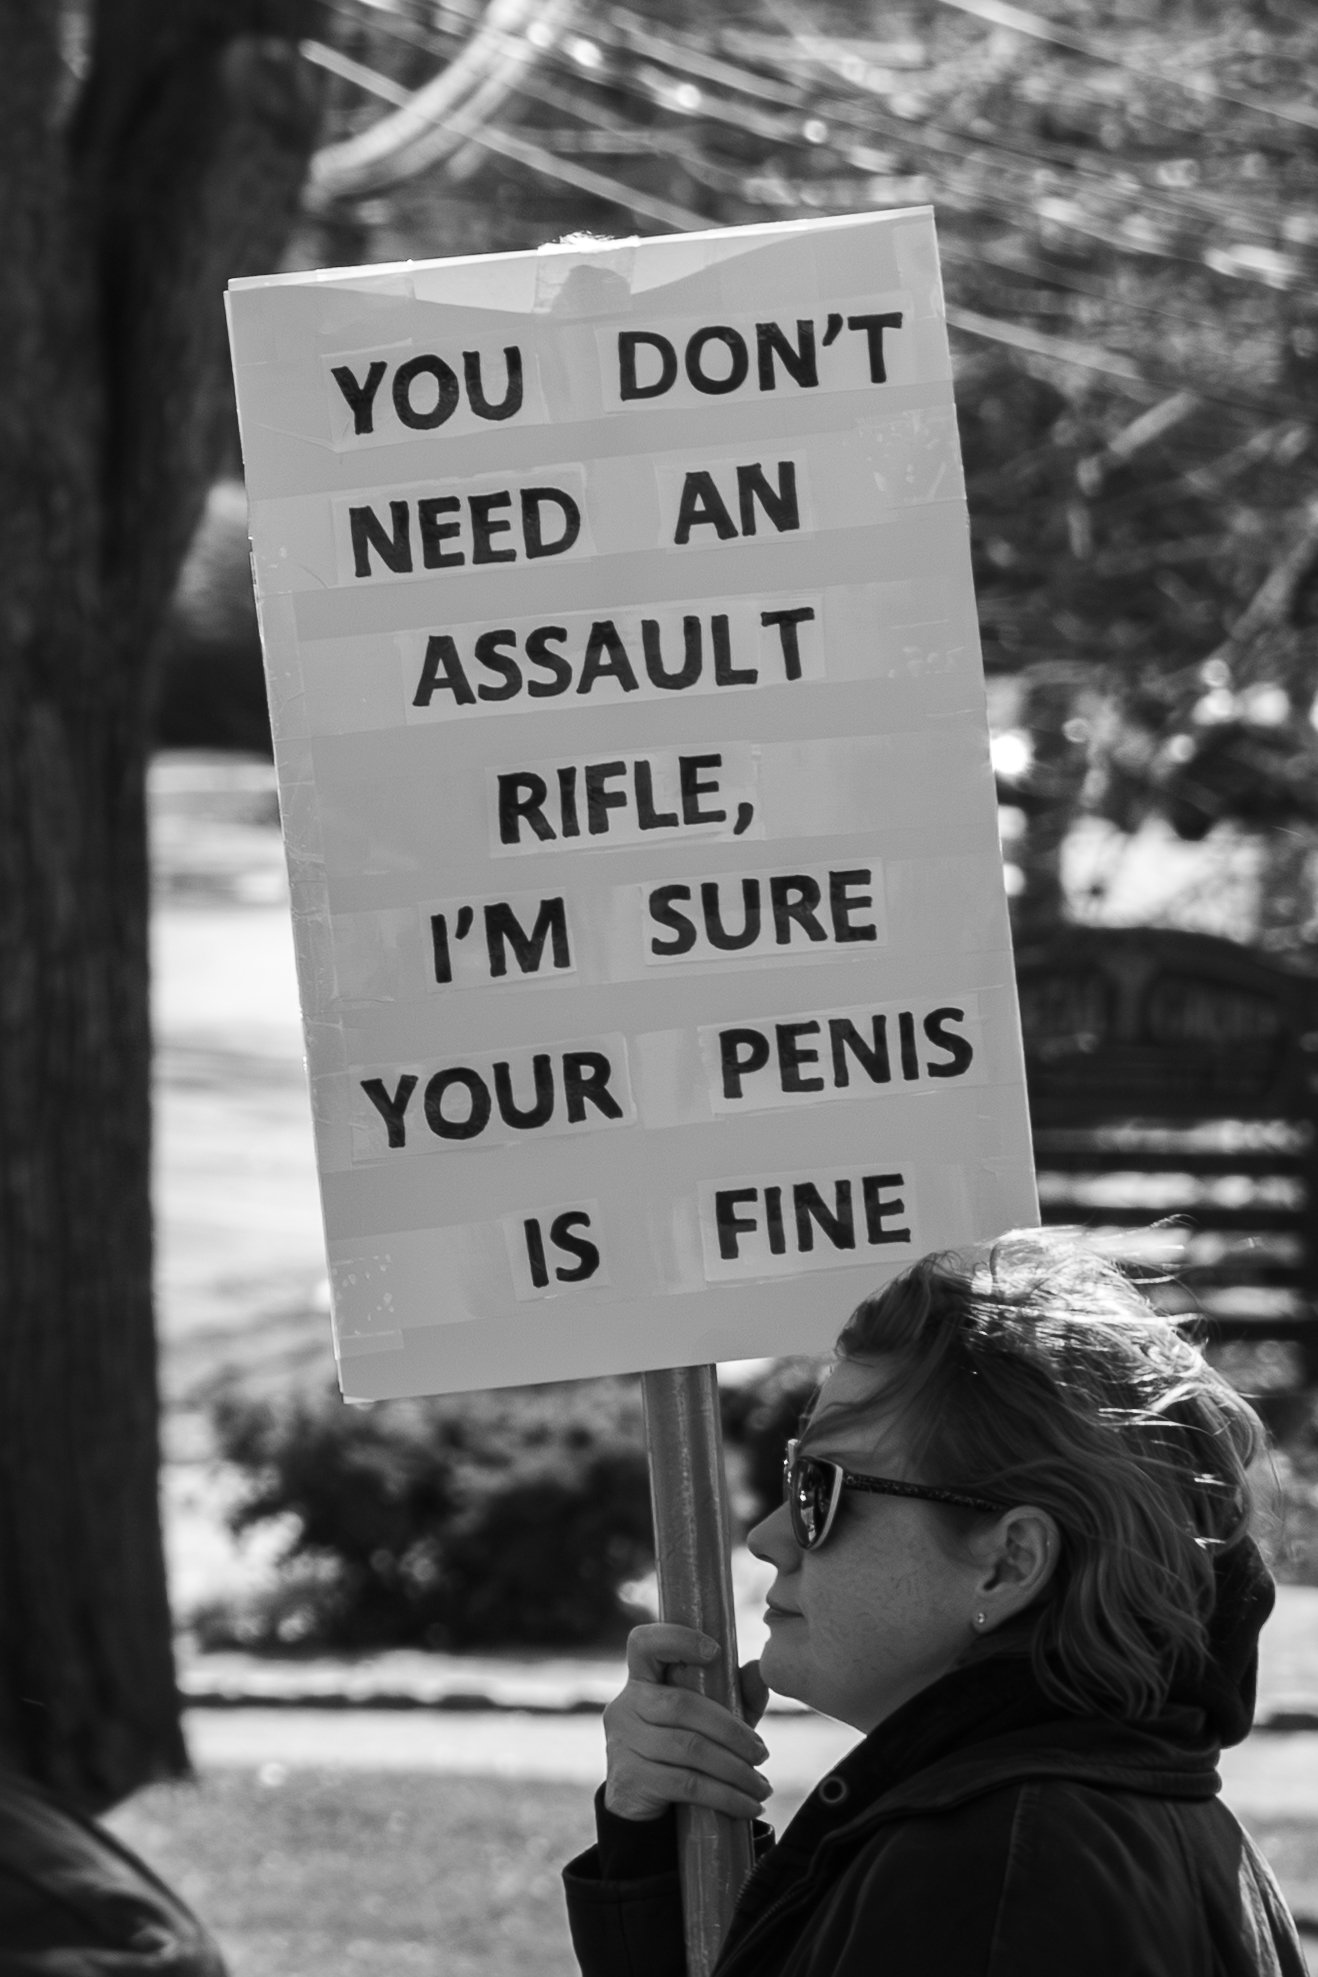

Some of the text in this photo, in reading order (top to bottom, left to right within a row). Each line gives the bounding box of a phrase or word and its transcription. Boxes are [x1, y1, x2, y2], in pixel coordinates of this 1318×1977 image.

[330, 312, 903, 435] YOU DON'T
[348, 461, 800, 578] NEED AN
[412, 606, 815, 707] ASSAULT
[497, 753, 754, 845] RIFLE,
[430, 869, 877, 984] I'M SURE
[360, 1007, 974, 1149] YOUR PENIS
[523, 1173, 911, 1289] IS FINE
